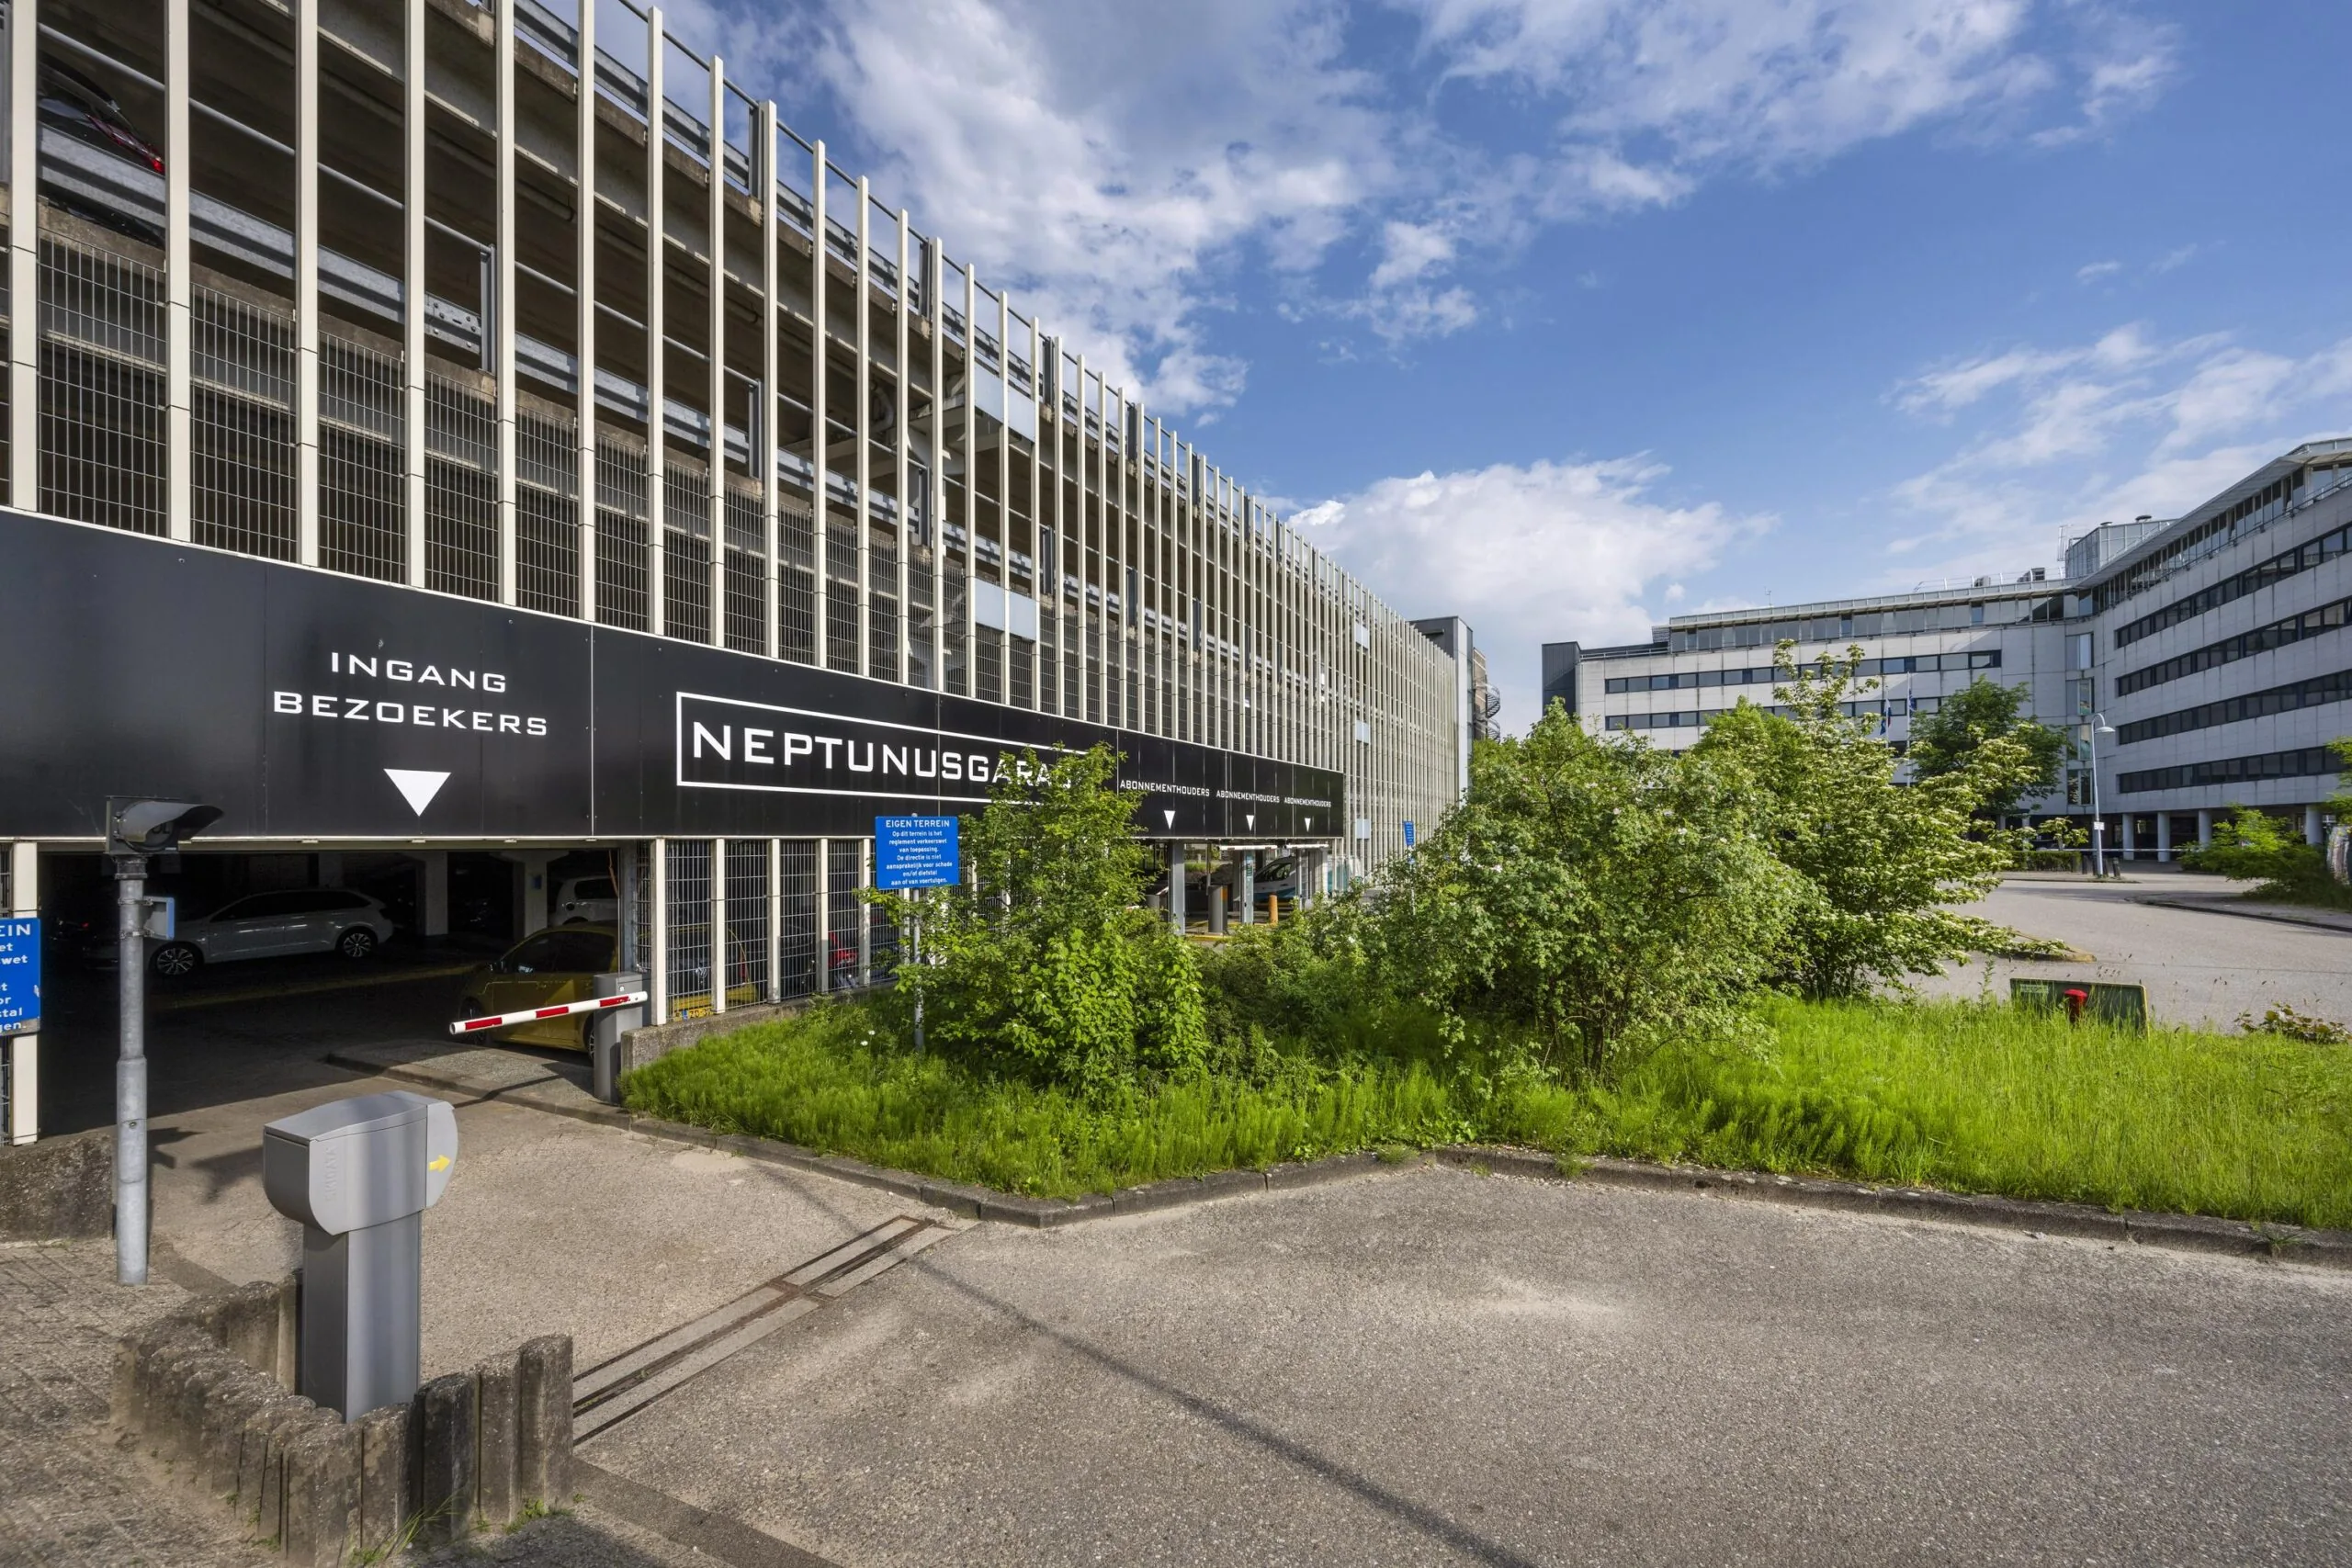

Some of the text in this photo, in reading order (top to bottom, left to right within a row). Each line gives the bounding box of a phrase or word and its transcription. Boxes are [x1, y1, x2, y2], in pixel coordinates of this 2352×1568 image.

[332, 651, 506, 694] INGANG
[274, 691, 547, 736] BEZOEKERS
[693, 721, 1084, 790] NEPTUNUSGARA
[1120, 779, 1210, 797] ABONNEMENTHOUDERS
[1216, 790, 1280, 804] ABONNEMENTHOUDERS
[1284, 796, 1331, 808] ABONNEMENTHOUDERS
[885, 819, 950, 828] EIGEN TERREIN
